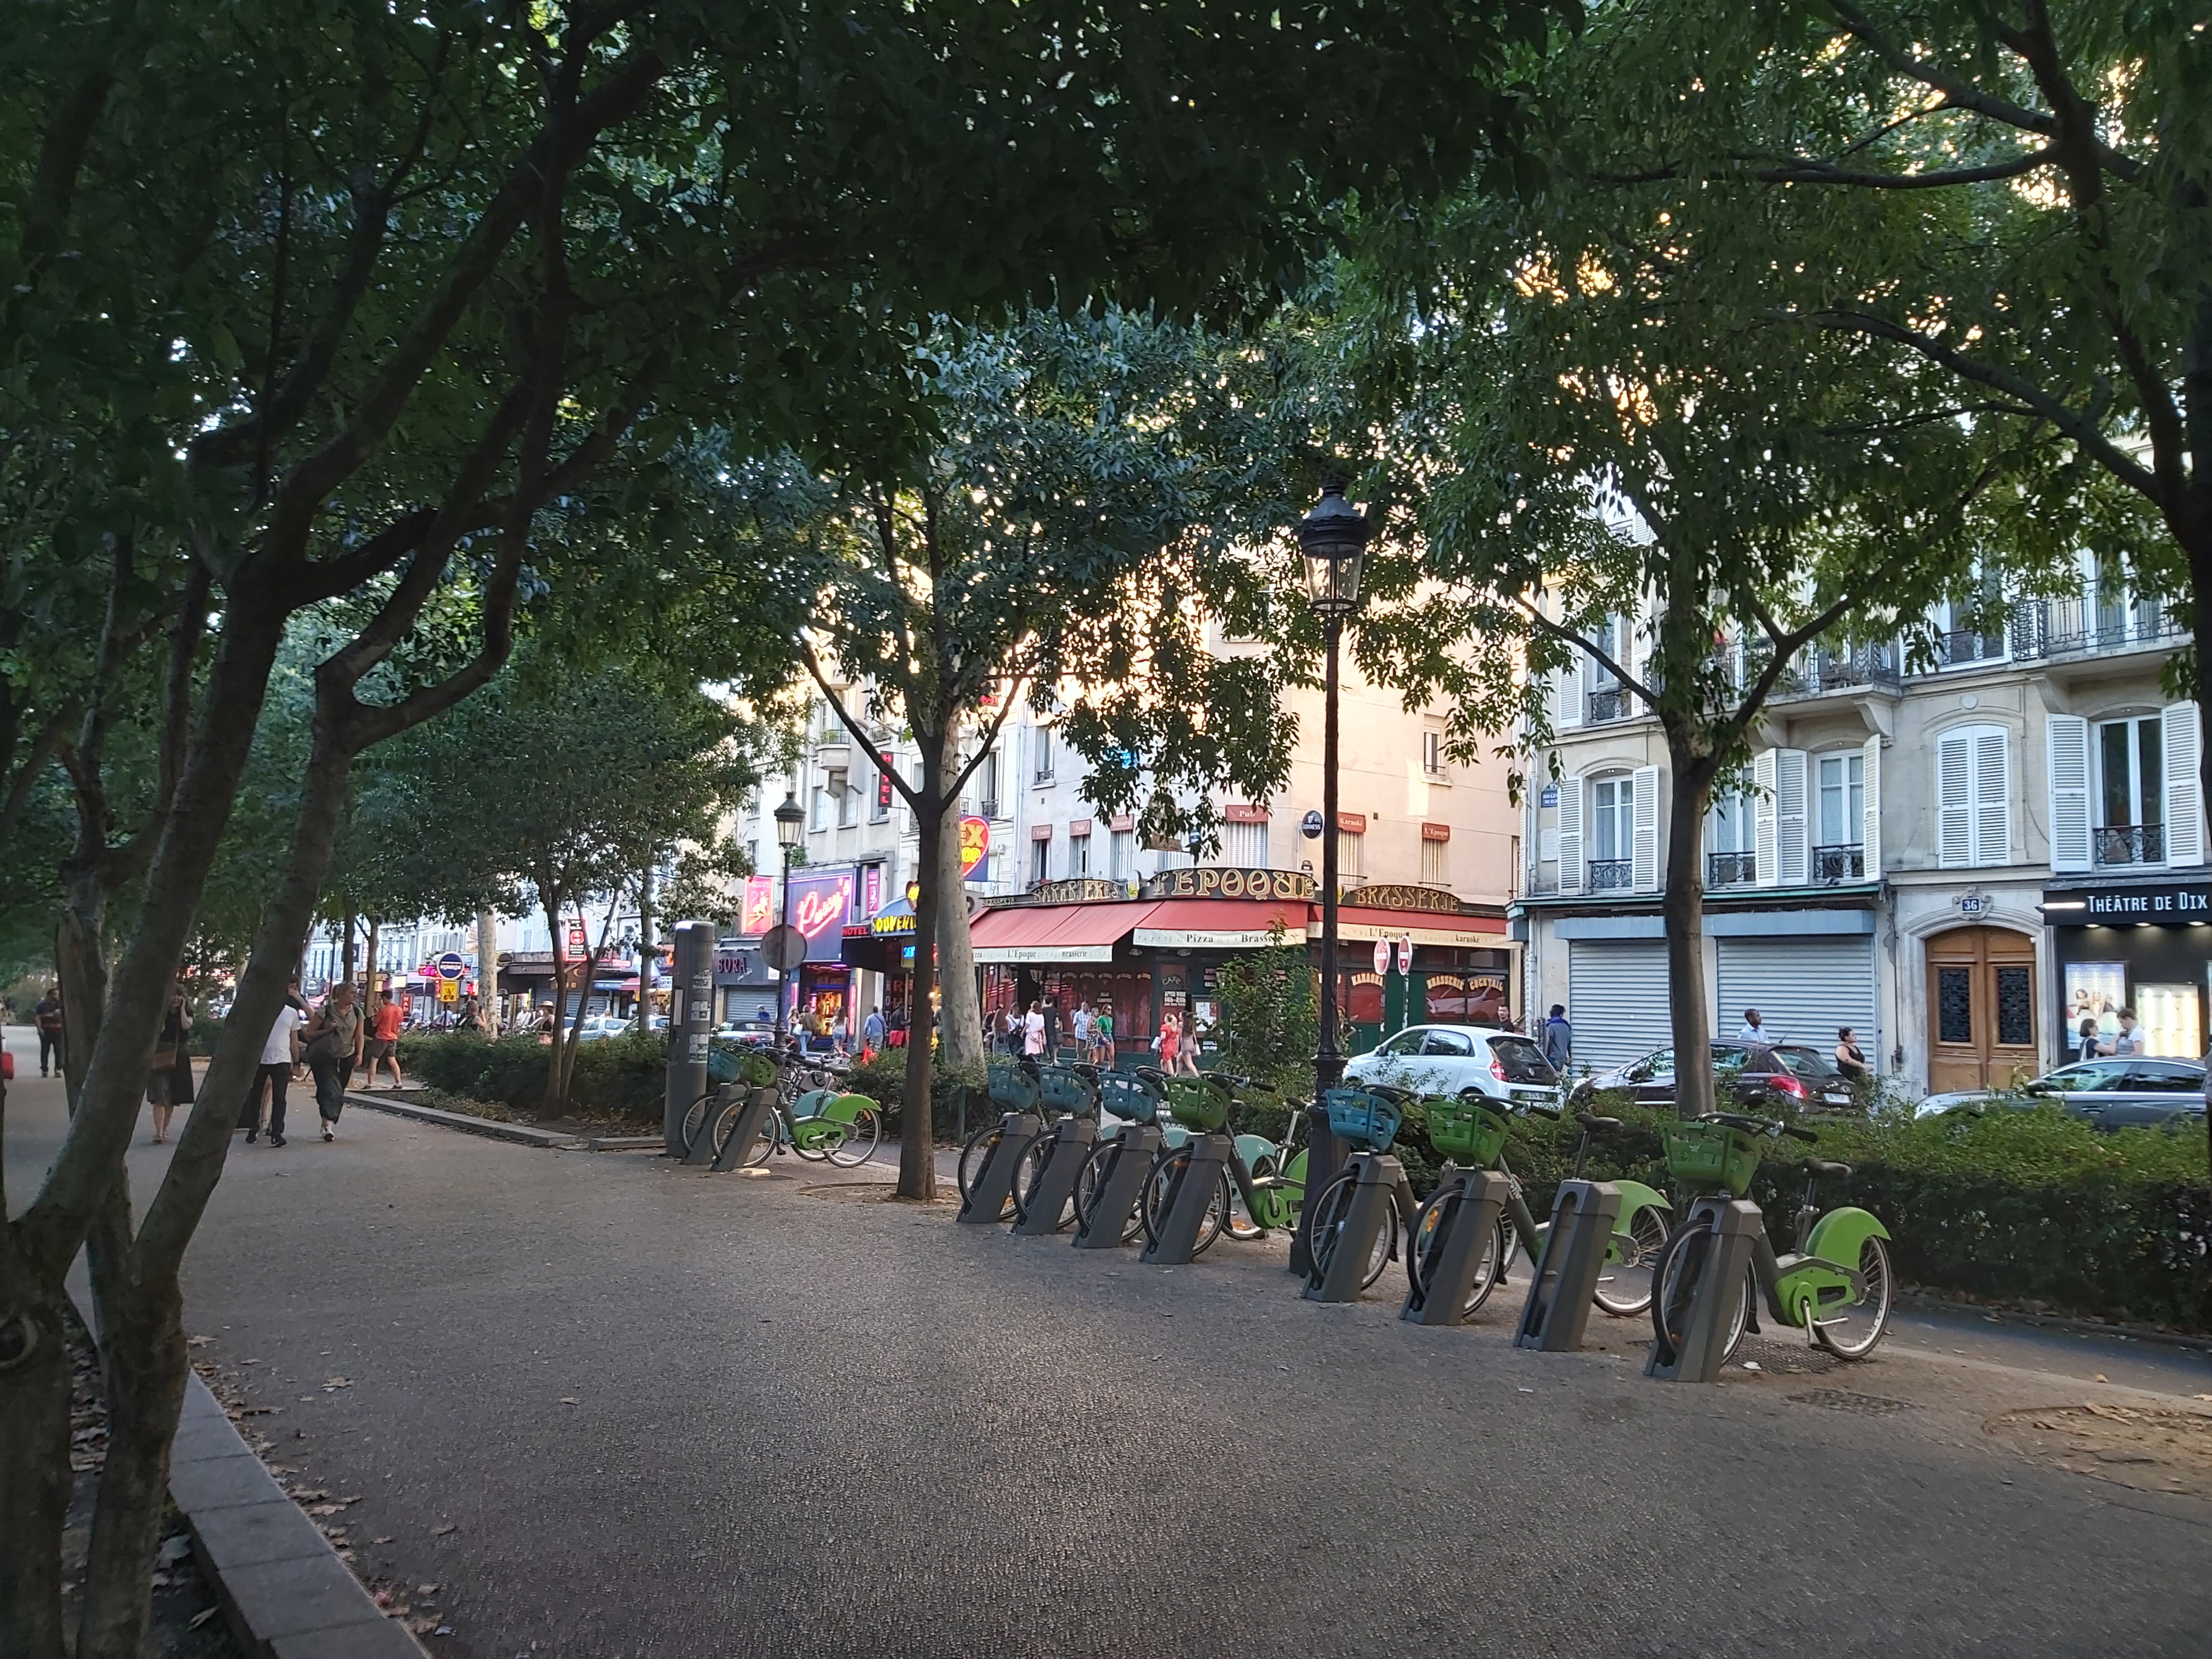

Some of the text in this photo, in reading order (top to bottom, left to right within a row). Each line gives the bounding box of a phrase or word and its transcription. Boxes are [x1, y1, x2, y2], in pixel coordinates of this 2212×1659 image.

[962, 847, 981, 863] OP
[1153, 868, 1314, 900] L'EPOQUE
[1356, 887, 1459, 911] BRASSERIE
[1964, 900, 1977, 910] 36
[843, 927, 868, 936] HOTEL
[873, 915, 916, 932] SOUVENI
[1186, 934, 1214, 943] Pizza
[1008, 949, 1036, 960] L'Epoque
[718, 957, 747, 973] BORA
